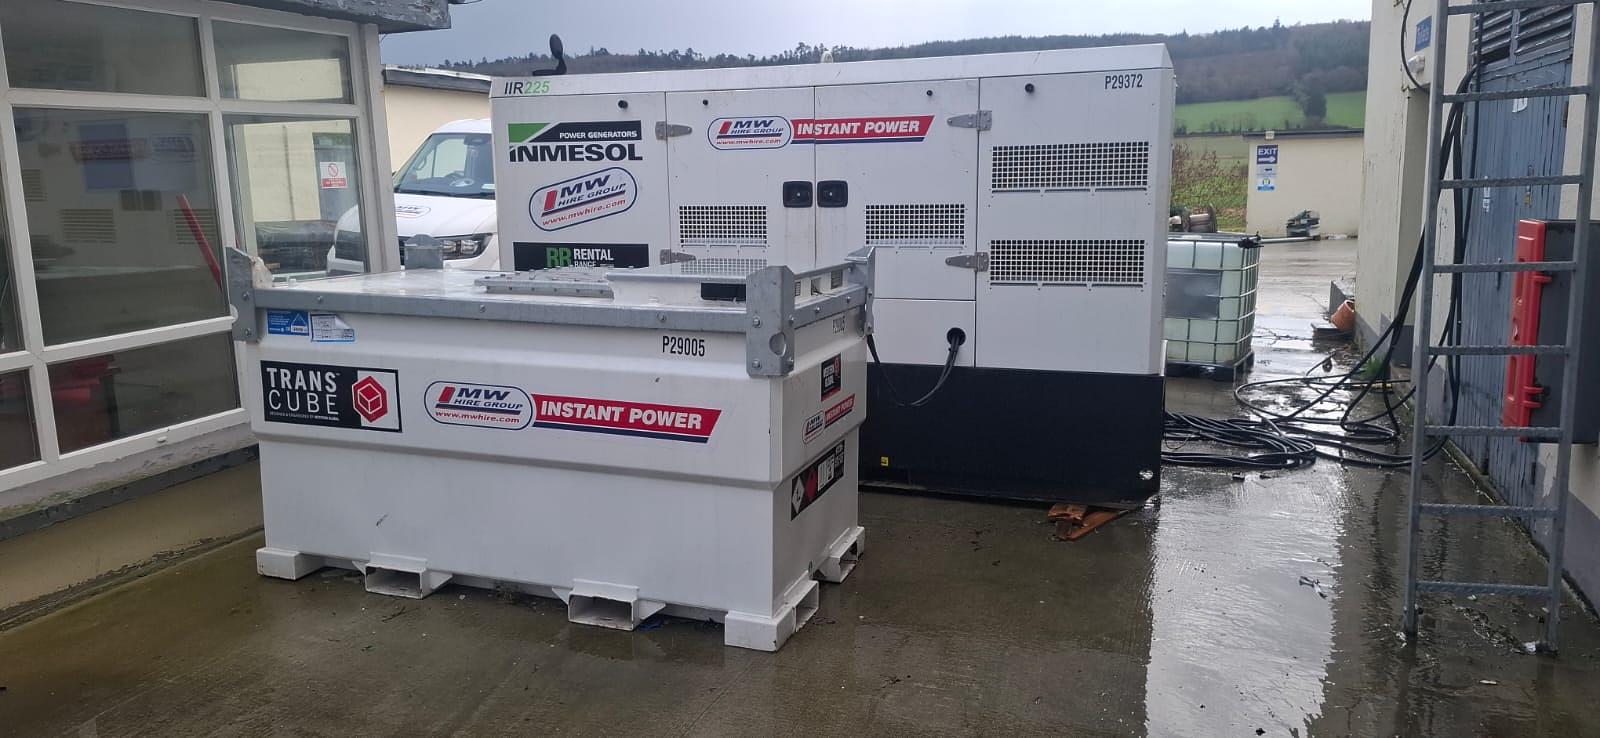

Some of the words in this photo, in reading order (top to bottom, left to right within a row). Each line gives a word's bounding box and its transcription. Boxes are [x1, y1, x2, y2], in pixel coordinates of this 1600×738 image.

[1105, 74, 1143, 90] P29372
[734, 119, 774, 129] MW
[797, 122, 860, 136] INSTANT
[864, 120, 920, 133] POWER
[559, 131, 586, 139] POWER
[588, 130, 638, 139] GENERATORS
[509, 143, 643, 162] INMESOL
[1258, 147, 1277, 155] EXIT
[560, 174, 611, 198] MW
[558, 195, 585, 207] HIRE
[587, 183, 627, 198] GROUP
[542, 199, 626, 227] www.mwhire.com
[546, 247, 572, 268] RR
[573, 248, 614, 260] RENTAL
[662, 335, 705, 357] P29005
[266, 367, 337, 393] TRANS
[268, 389, 340, 415] CUBE
[457, 387, 511, 401] MW
[454, 398, 482, 407] HIRE
[483, 401, 523, 409] GROUP
[435, 411, 520, 424] www.mwhire.com
[540, 400, 625, 423] INSTANT
[628, 407, 703, 430] POWER
